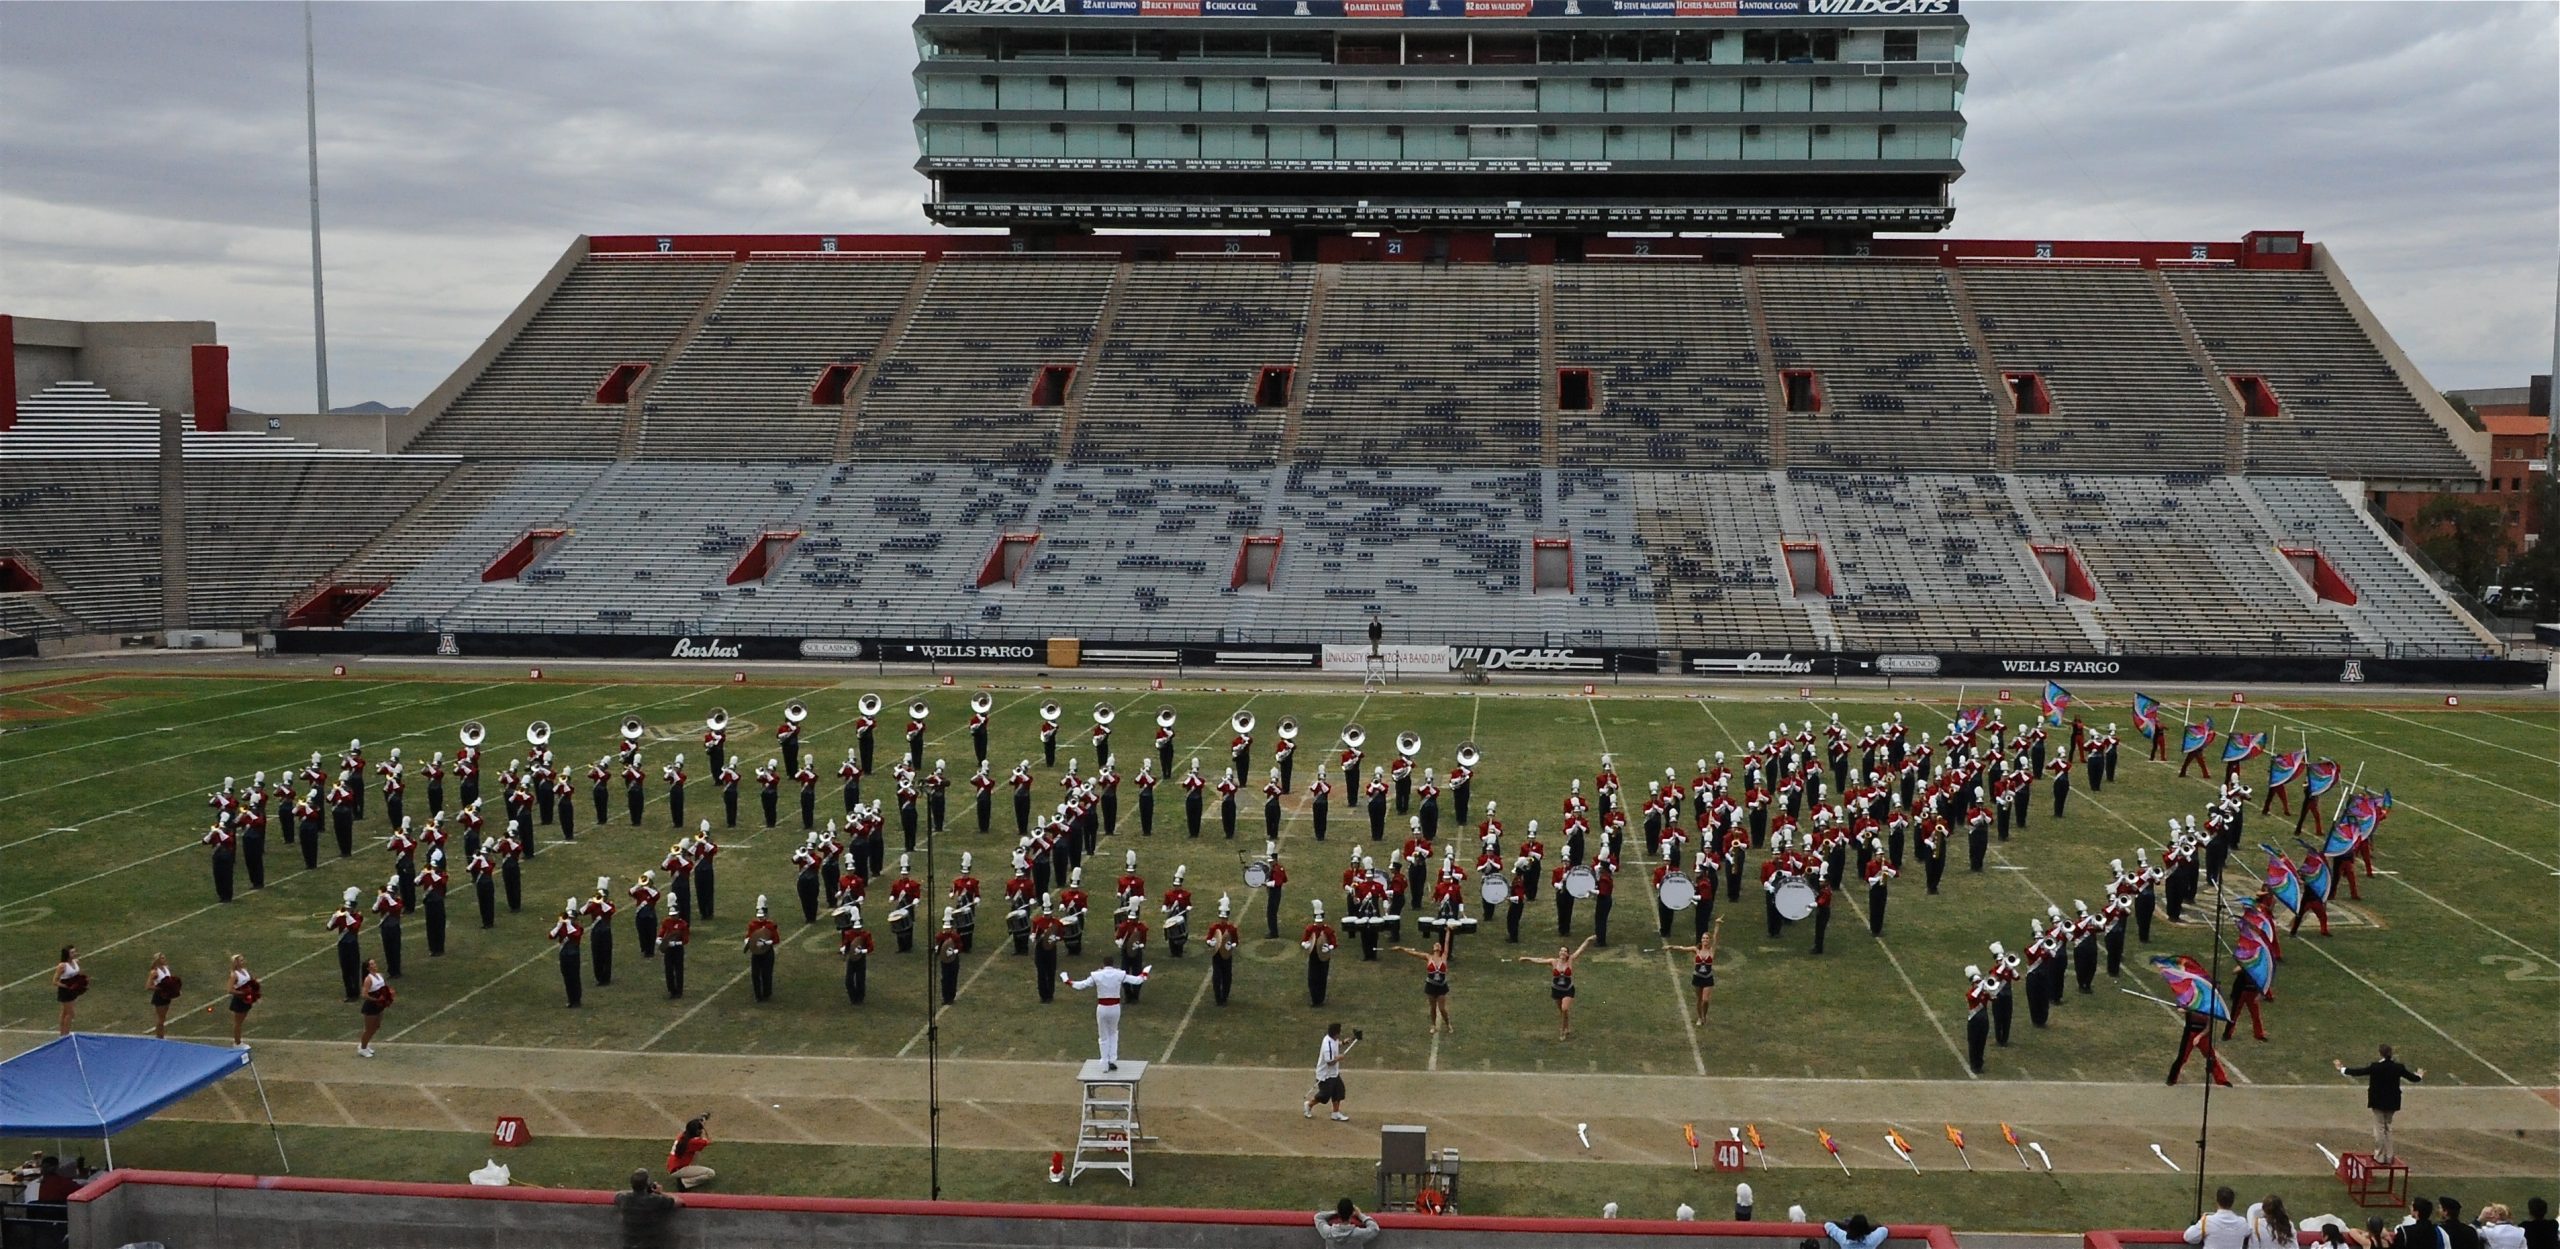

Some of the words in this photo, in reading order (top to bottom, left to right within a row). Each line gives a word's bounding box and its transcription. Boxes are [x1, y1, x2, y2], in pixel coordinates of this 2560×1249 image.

[939, 0, 1066, 13] ARIZONA
[1172, 2, 1200, 10] HUNLEY
[1212, 2, 1236, 10] CHUCK
[1238, 2, 1258, 10] CECIL
[1474, 2, 1490, 10] ROB
[1491, 2, 1525, 10] WALDROP
[1623, 2, 1639, 10] STEVE
[1640, 2, 1675, 10] McLAUGHLIN
[1682, 1, 1703, 10] CHRIS
[1703, 1, 1737, 10] McALISTER
[1744, 2, 1774, 10] ANTOINE
[1774, 2, 1798, 10] CASON
[1807, 0, 1950, 14] WILDCATS
[659, 242, 670, 252] 17
[823, 242, 836, 252] 18
[1225, 243, 1240, 252] 20
[1388, 243, 1401, 253] 21
[1635, 245, 1649, 254] 22
[1856, 246, 1870, 256] 23
[2036, 248, 2051, 258] 24
[2192, 250, 2206, 259] 25
[269, 418, 280, 428] 16
[671, 638, 742, 658] Bashas'
[821, 644, 857, 652] CASINOS
[920, 645, 976, 658] WELLS
[980, 646, 1034, 658] FARGO
[1325, 652, 1364, 662] UNIVERSITY
[1409, 653, 1430, 664] BAND
[1432, 654, 1446, 664] DAY
[2002, 660, 2060, 672] WELLS
[2064, 661, 2120, 673] FARGO
[496, 1120, 516, 1142] 40
[1718, 1145, 1739, 1168] 40
